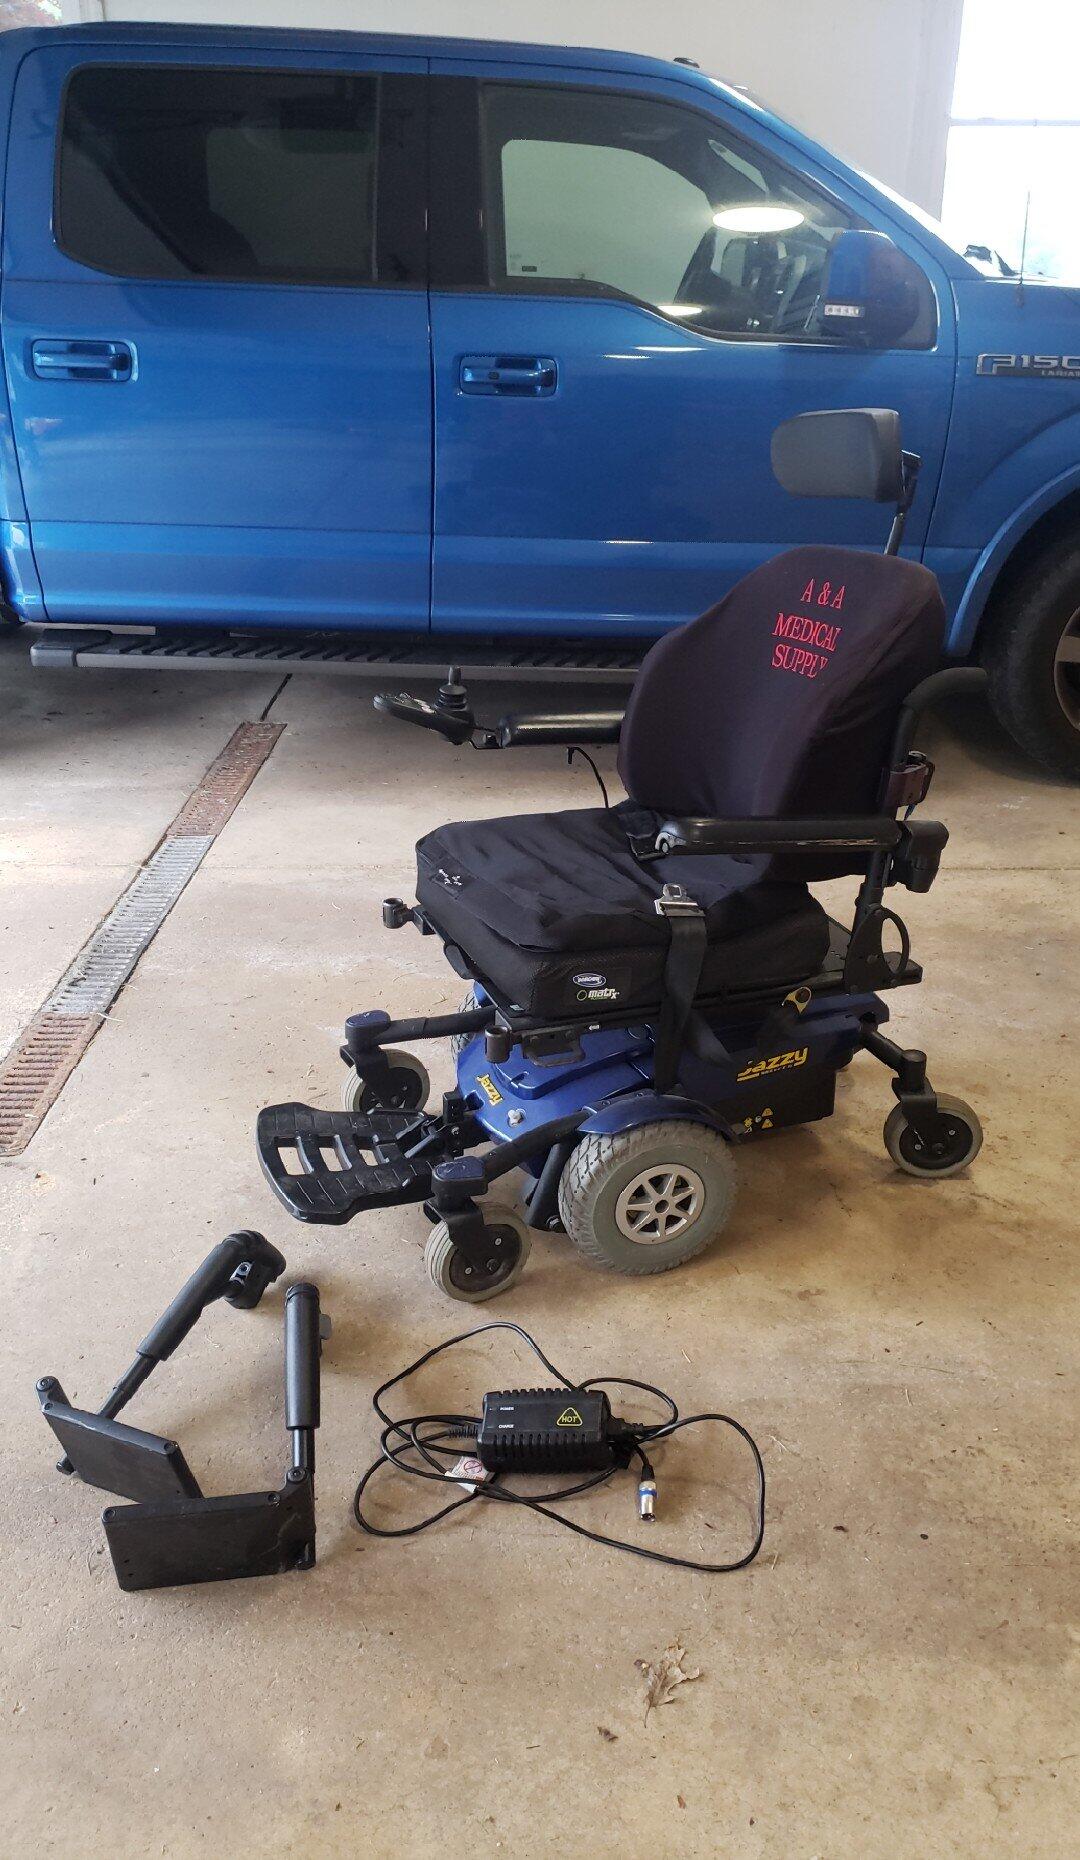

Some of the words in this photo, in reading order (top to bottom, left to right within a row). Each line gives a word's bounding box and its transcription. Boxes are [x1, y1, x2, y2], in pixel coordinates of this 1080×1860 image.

[800, 578, 815, 603] A
[817, 581, 831, 606] &
[830, 585, 846, 609] A
[771, 612, 842, 652] MEDICAL
[771, 643, 829, 679] SUPPLY
[561, 1415, 578, 1424] HOT
